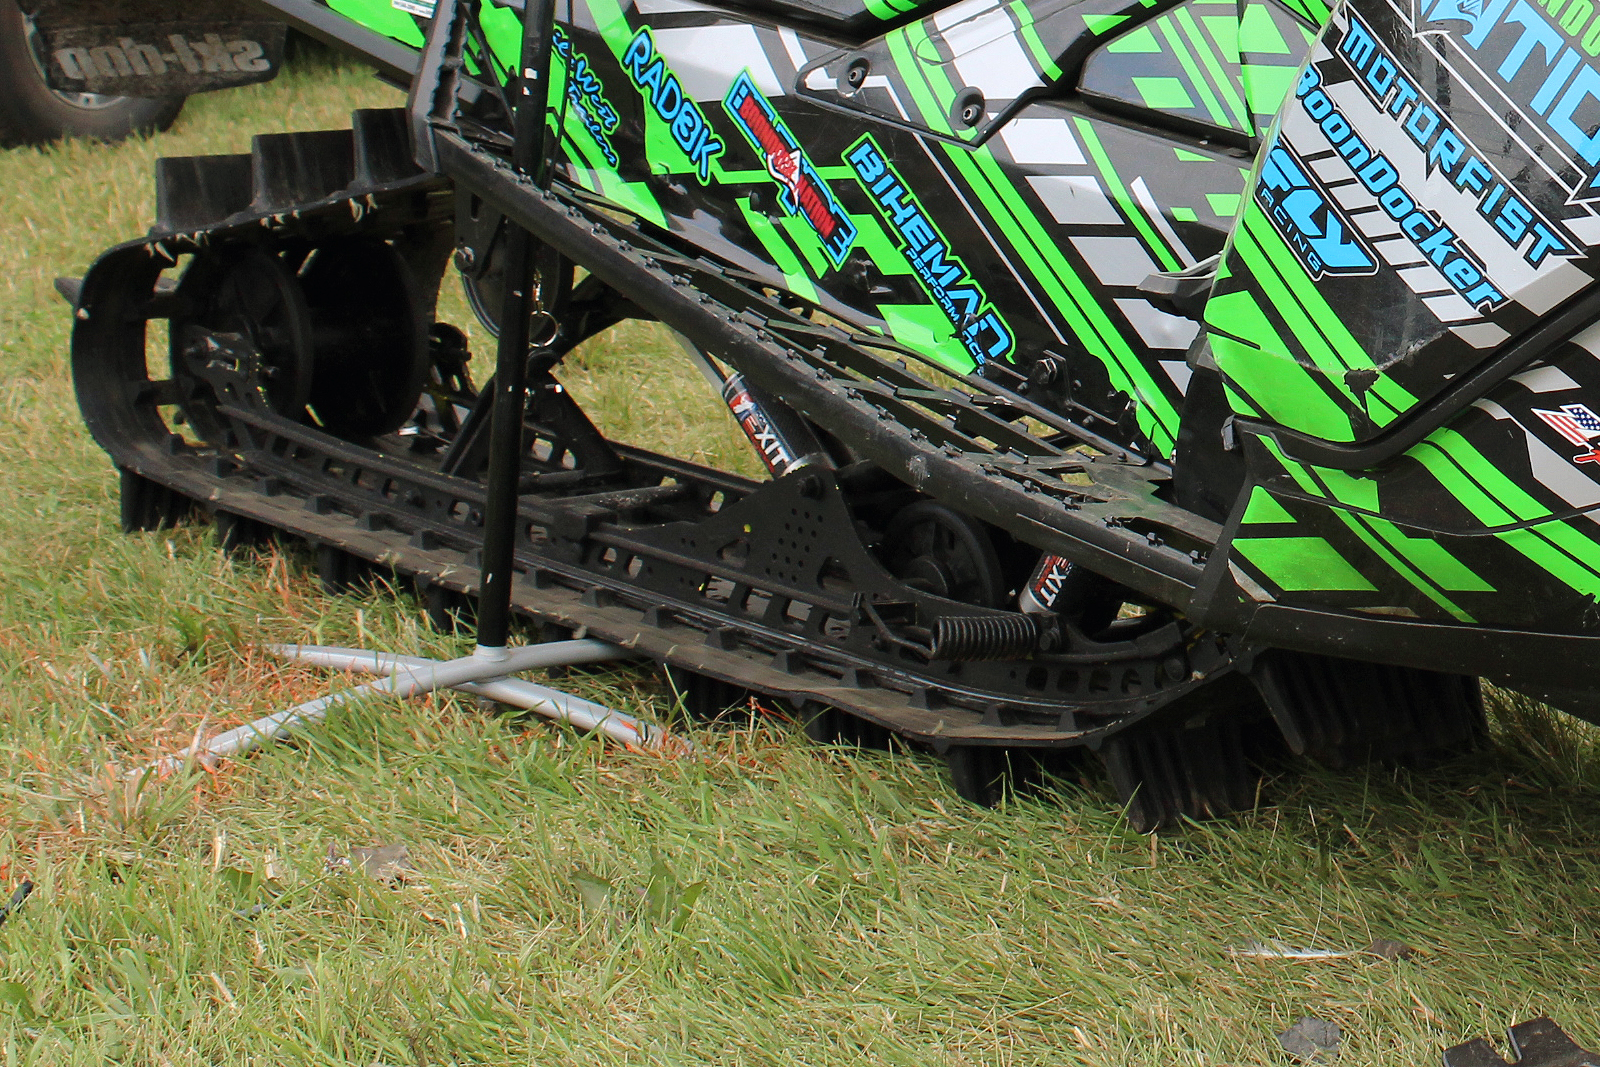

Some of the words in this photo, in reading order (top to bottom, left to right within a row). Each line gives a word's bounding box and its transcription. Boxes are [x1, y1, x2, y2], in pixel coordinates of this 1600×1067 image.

[1261, 145, 1373, 268] FLY
[1343, 20, 1566, 262] MOTORFIST
[850, 143, 1010, 358] BIKEMAN
[745, 414, 793, 466] EXIT
